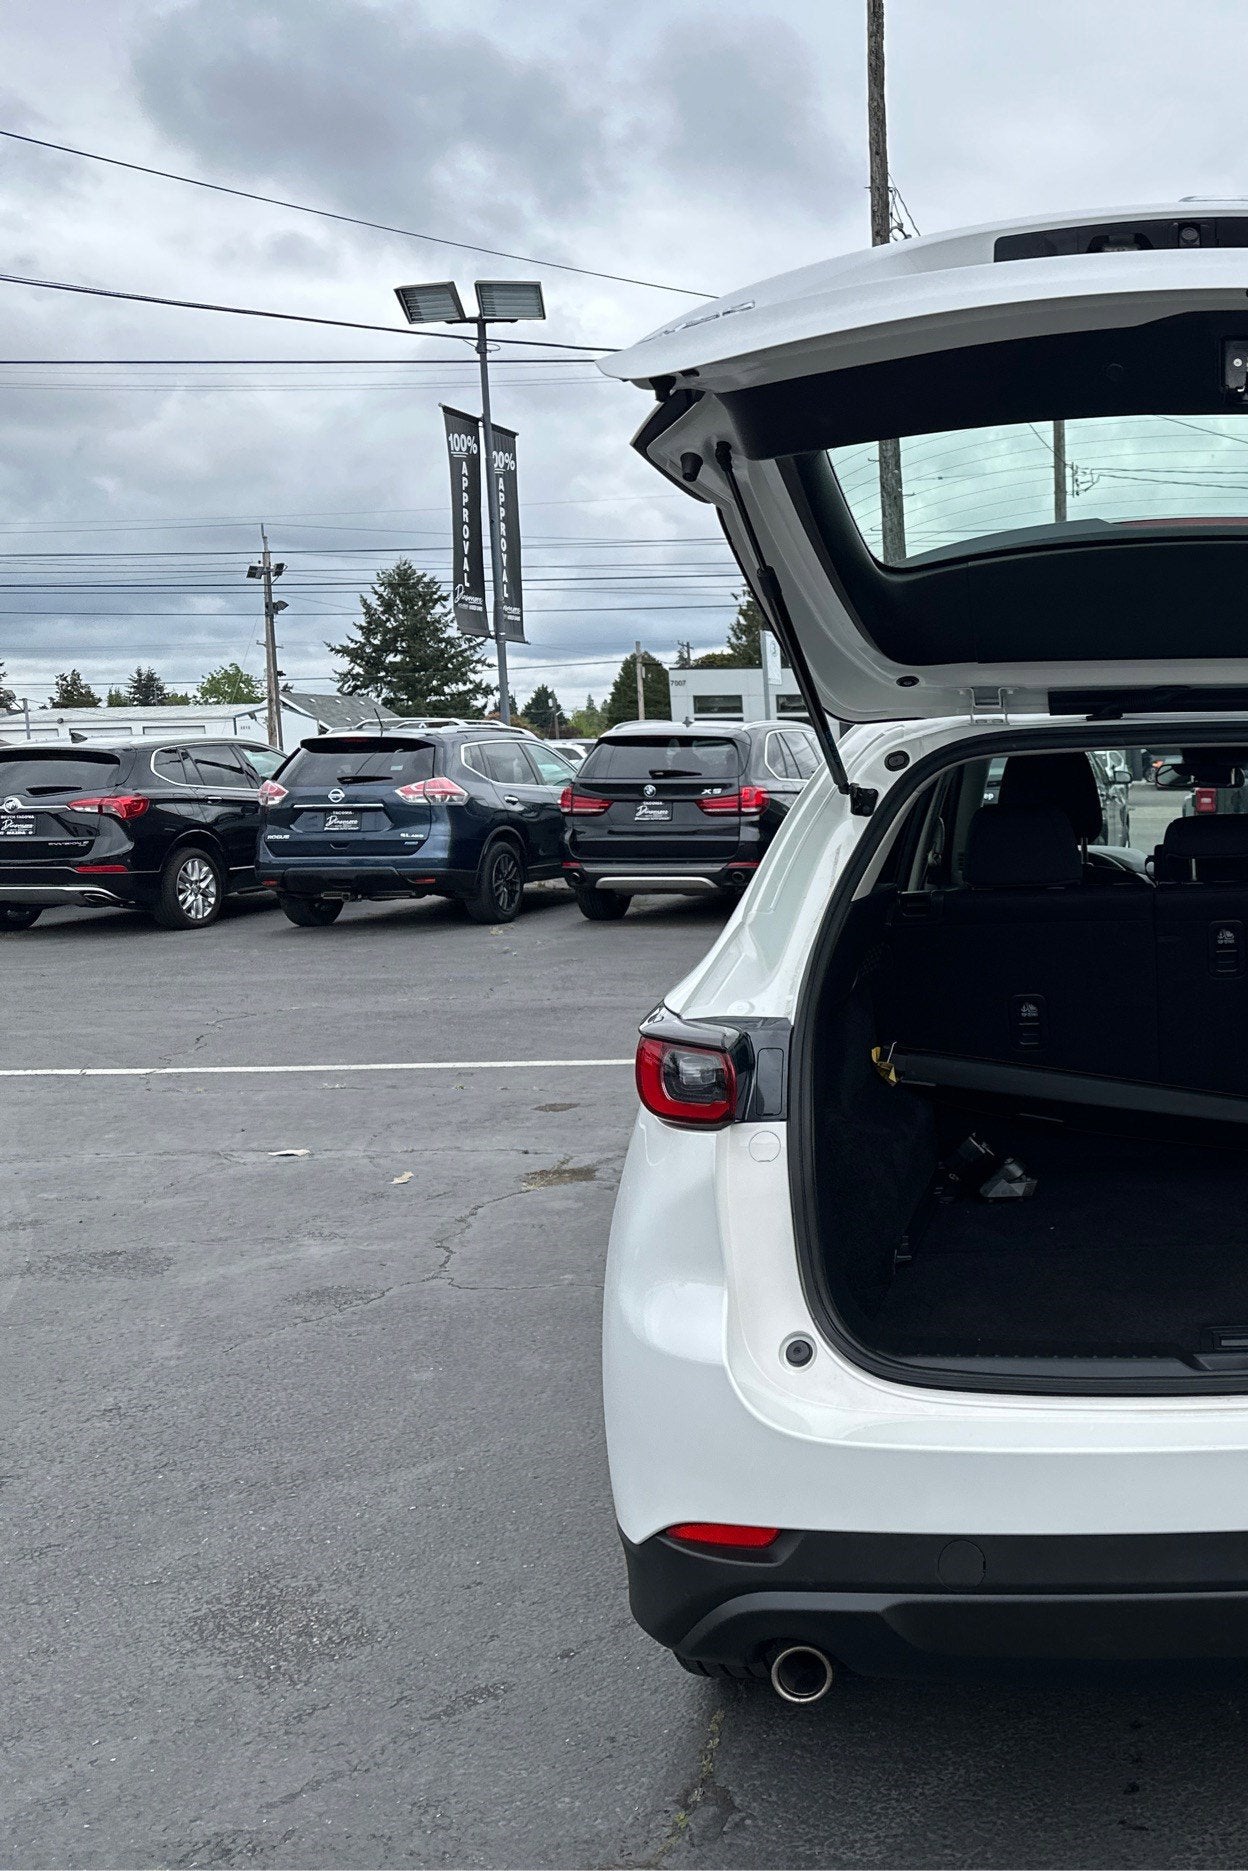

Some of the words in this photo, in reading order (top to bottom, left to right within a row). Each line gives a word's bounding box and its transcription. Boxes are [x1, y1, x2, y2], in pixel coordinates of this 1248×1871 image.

[448, 433, 478, 454] 100%
[461, 461, 470, 588] APPROVAL
[498, 477, 509, 598] APPROVAL
